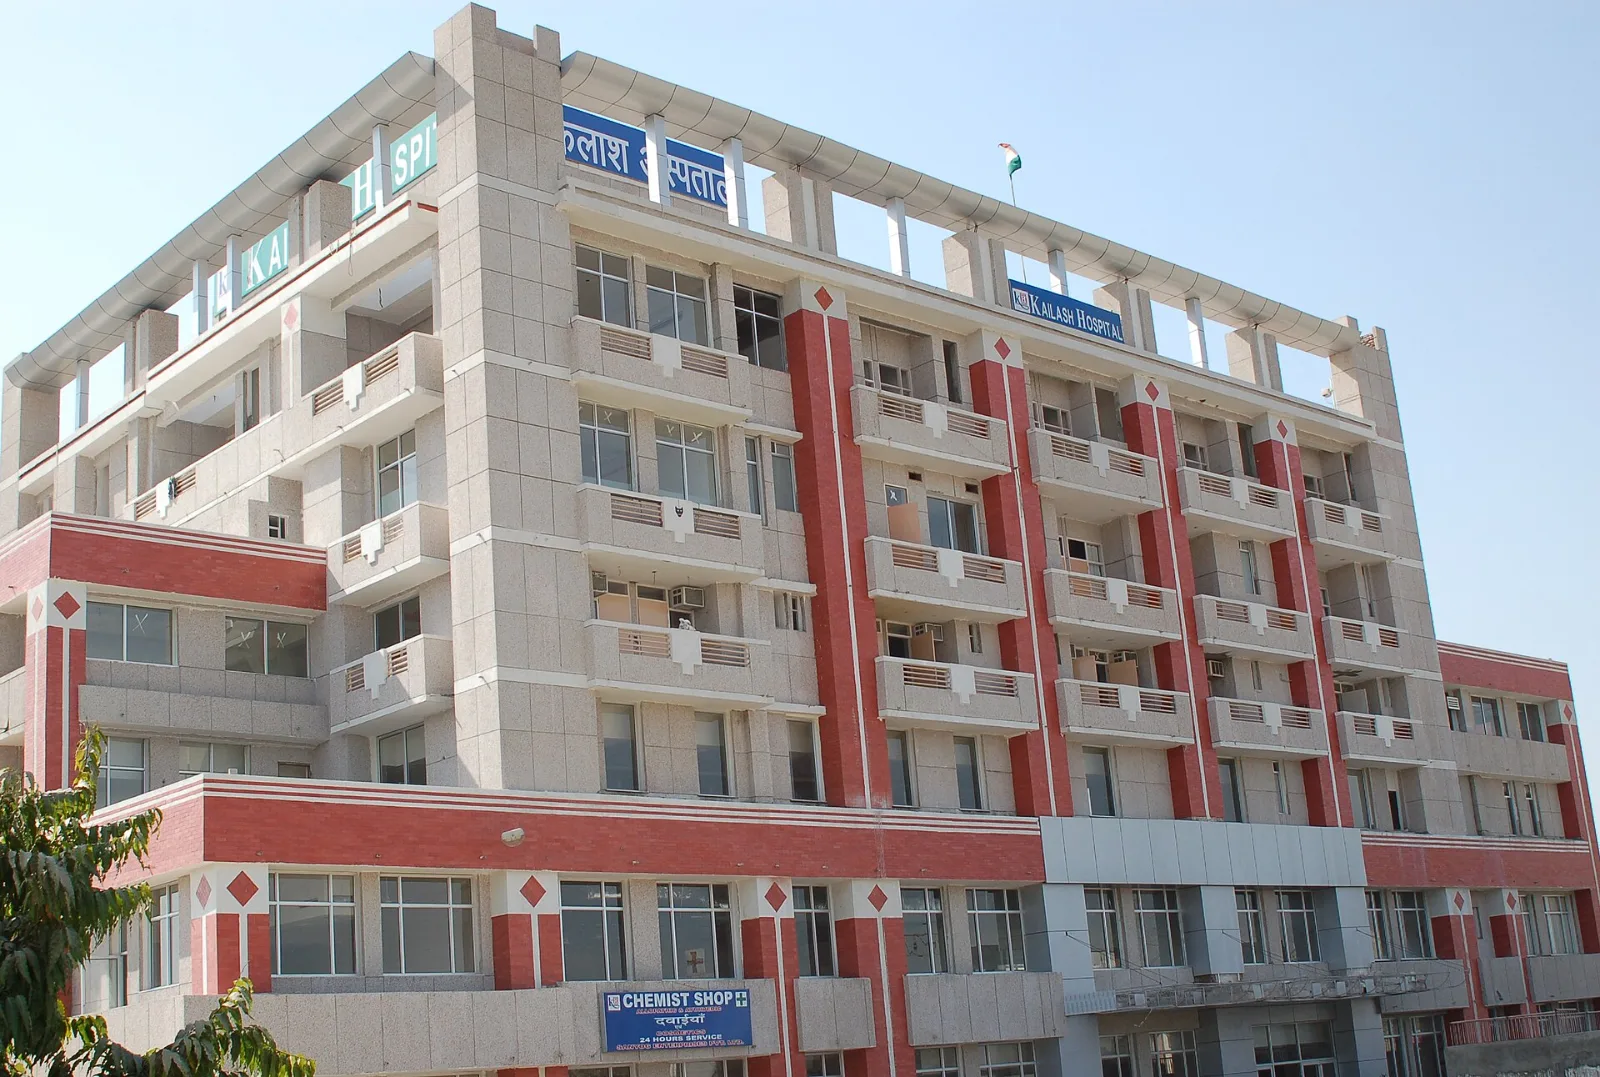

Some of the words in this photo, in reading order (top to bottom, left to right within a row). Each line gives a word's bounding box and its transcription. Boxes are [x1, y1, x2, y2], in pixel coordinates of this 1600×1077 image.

[354, 122, 437, 215] HSPI
[1029, 293, 1075, 326] KAILASH
[1076, 308, 1123, 341] HOSPITAL
[622, 992, 690, 1008] CHEMIST
[694, 991, 733, 1006] SHOP
